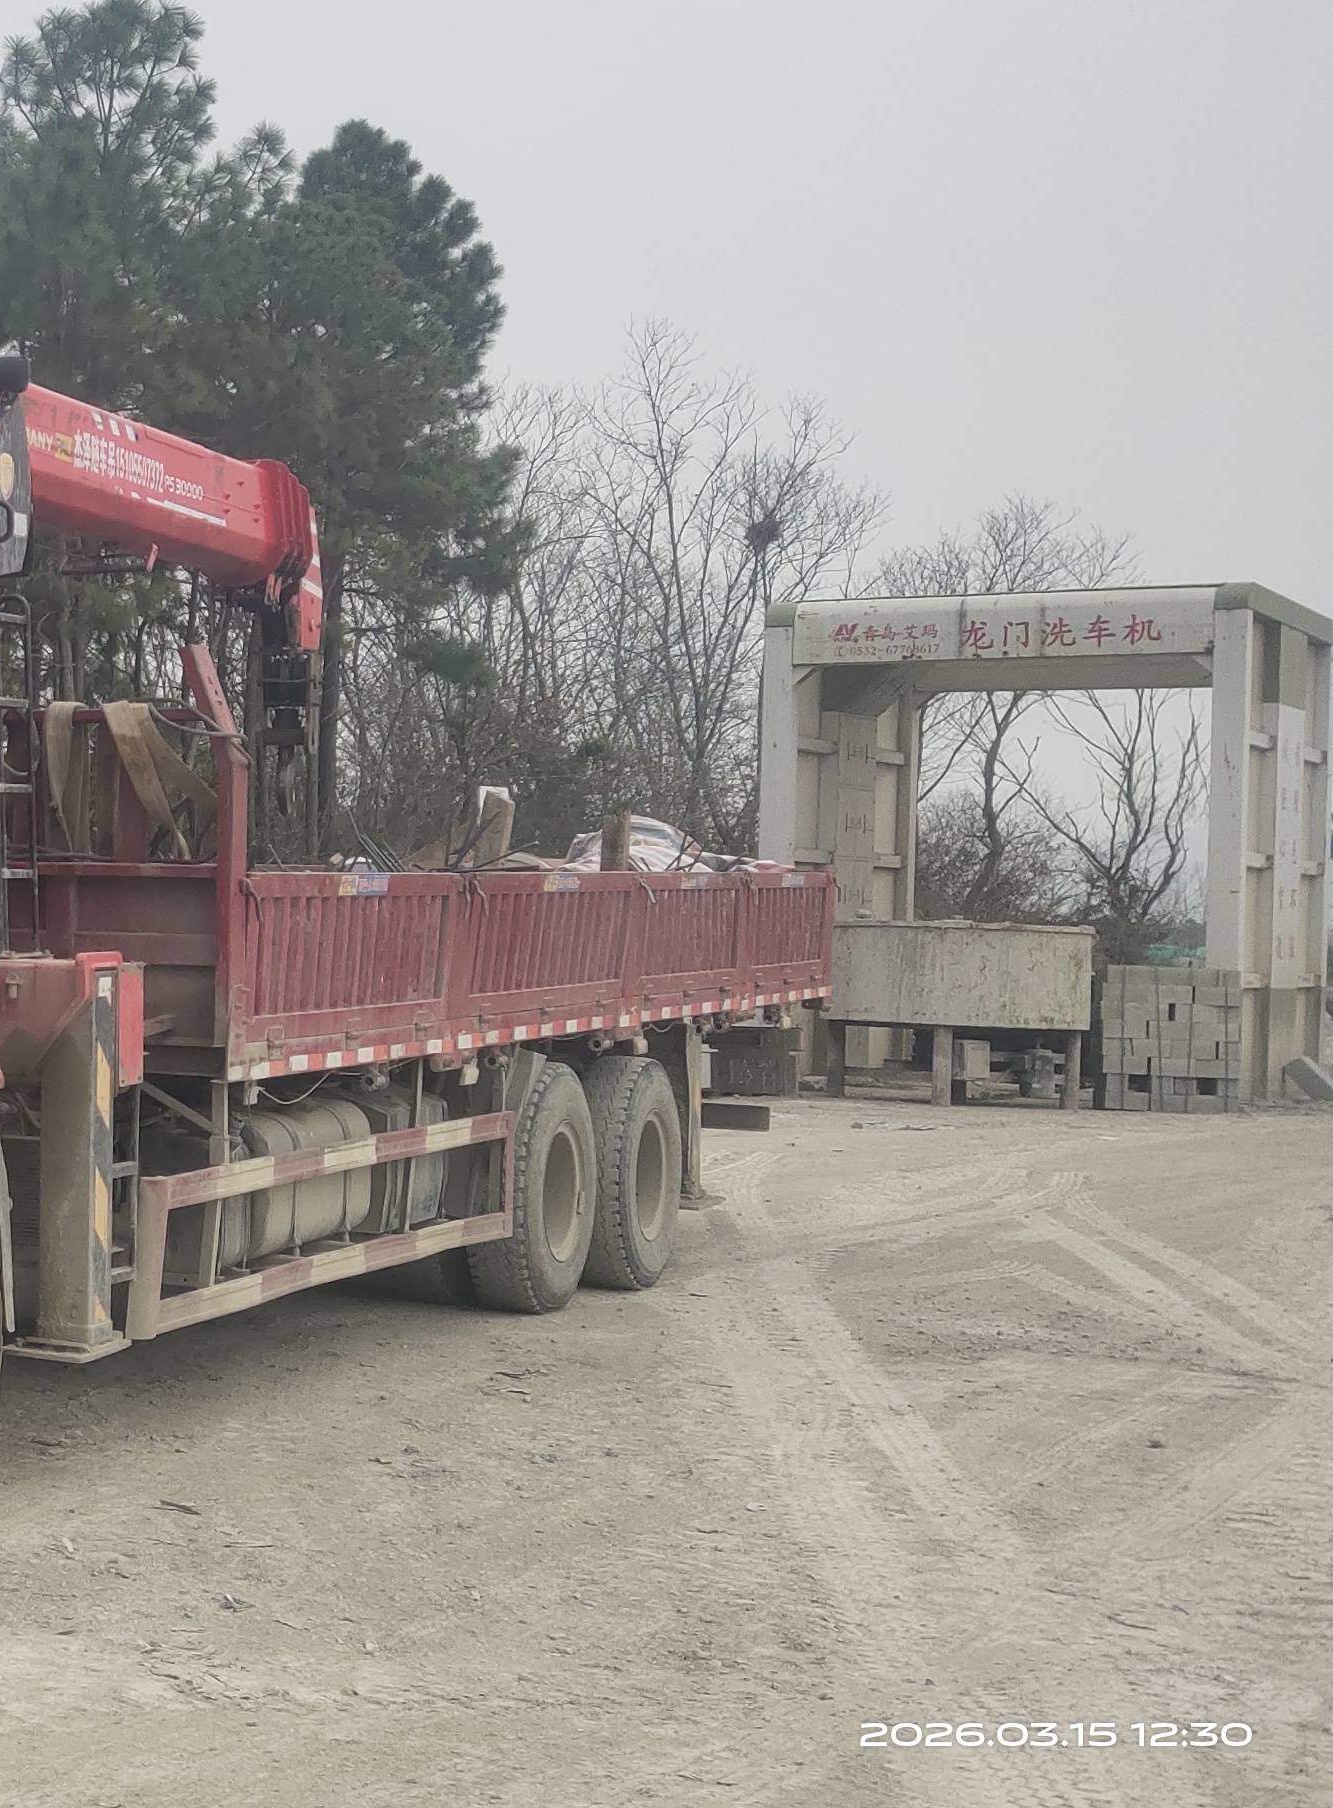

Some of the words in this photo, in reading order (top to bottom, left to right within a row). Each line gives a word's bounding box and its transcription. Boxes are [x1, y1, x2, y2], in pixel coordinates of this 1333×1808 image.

[963, 614, 1162, 650] 龙门洗车机
